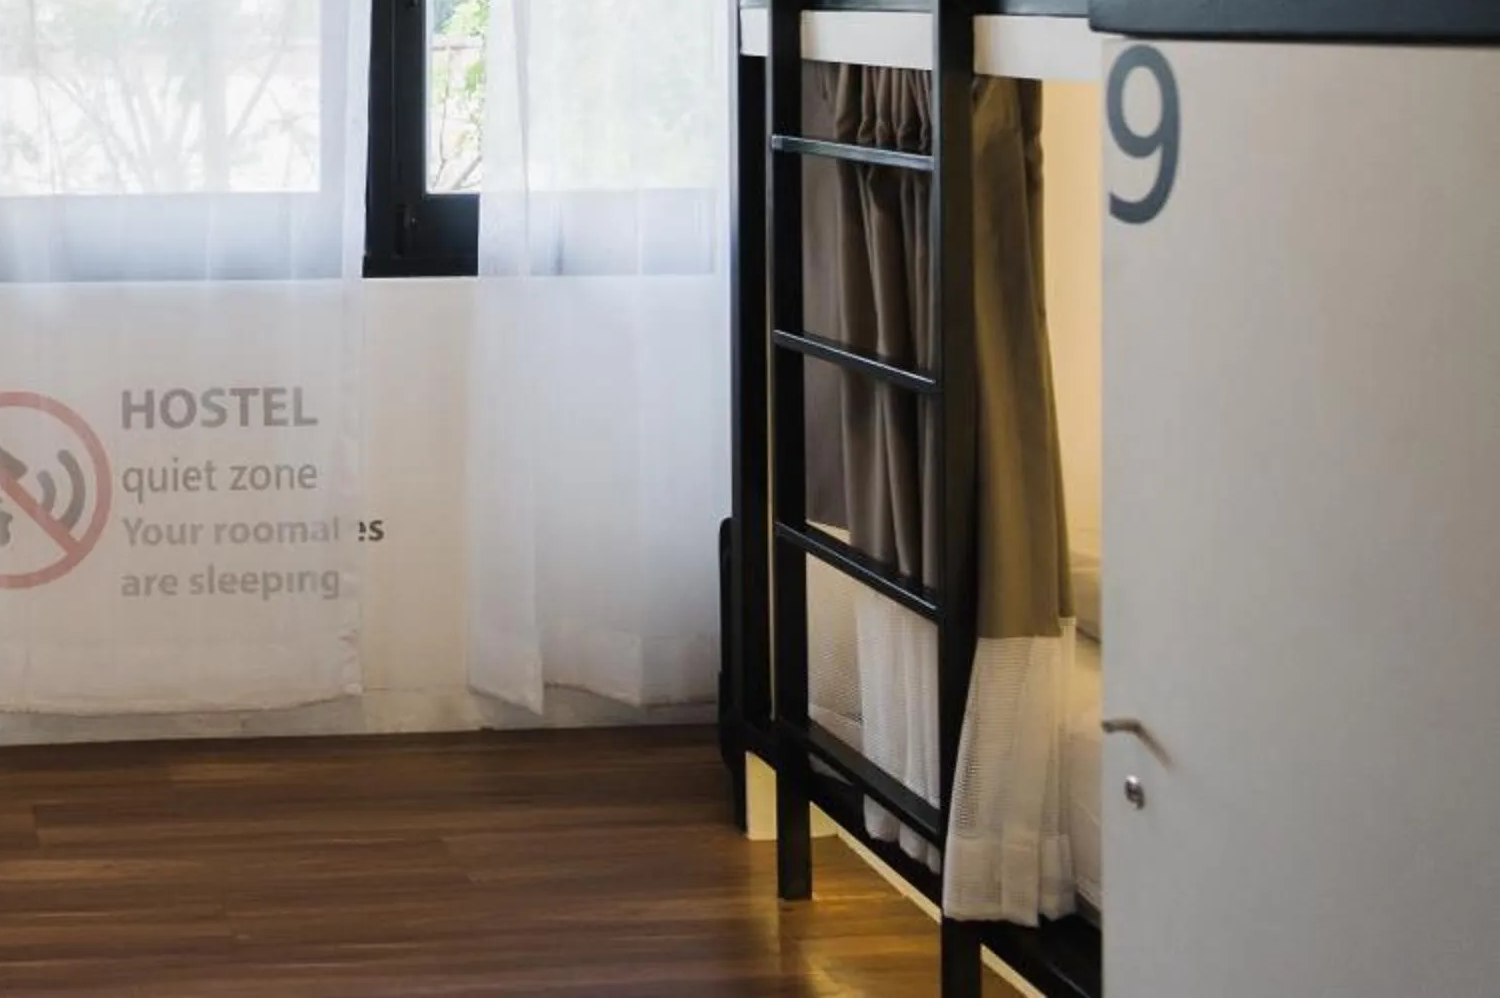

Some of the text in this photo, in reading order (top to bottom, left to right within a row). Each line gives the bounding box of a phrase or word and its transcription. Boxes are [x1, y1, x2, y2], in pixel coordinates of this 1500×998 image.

[1106, 44, 1181, 224] 9
[120, 387, 319, 429] HOSTEL
[121, 458, 318, 504] quiet zone
[122, 516, 203, 546] Your
[120, 564, 341, 601] are sleeping
